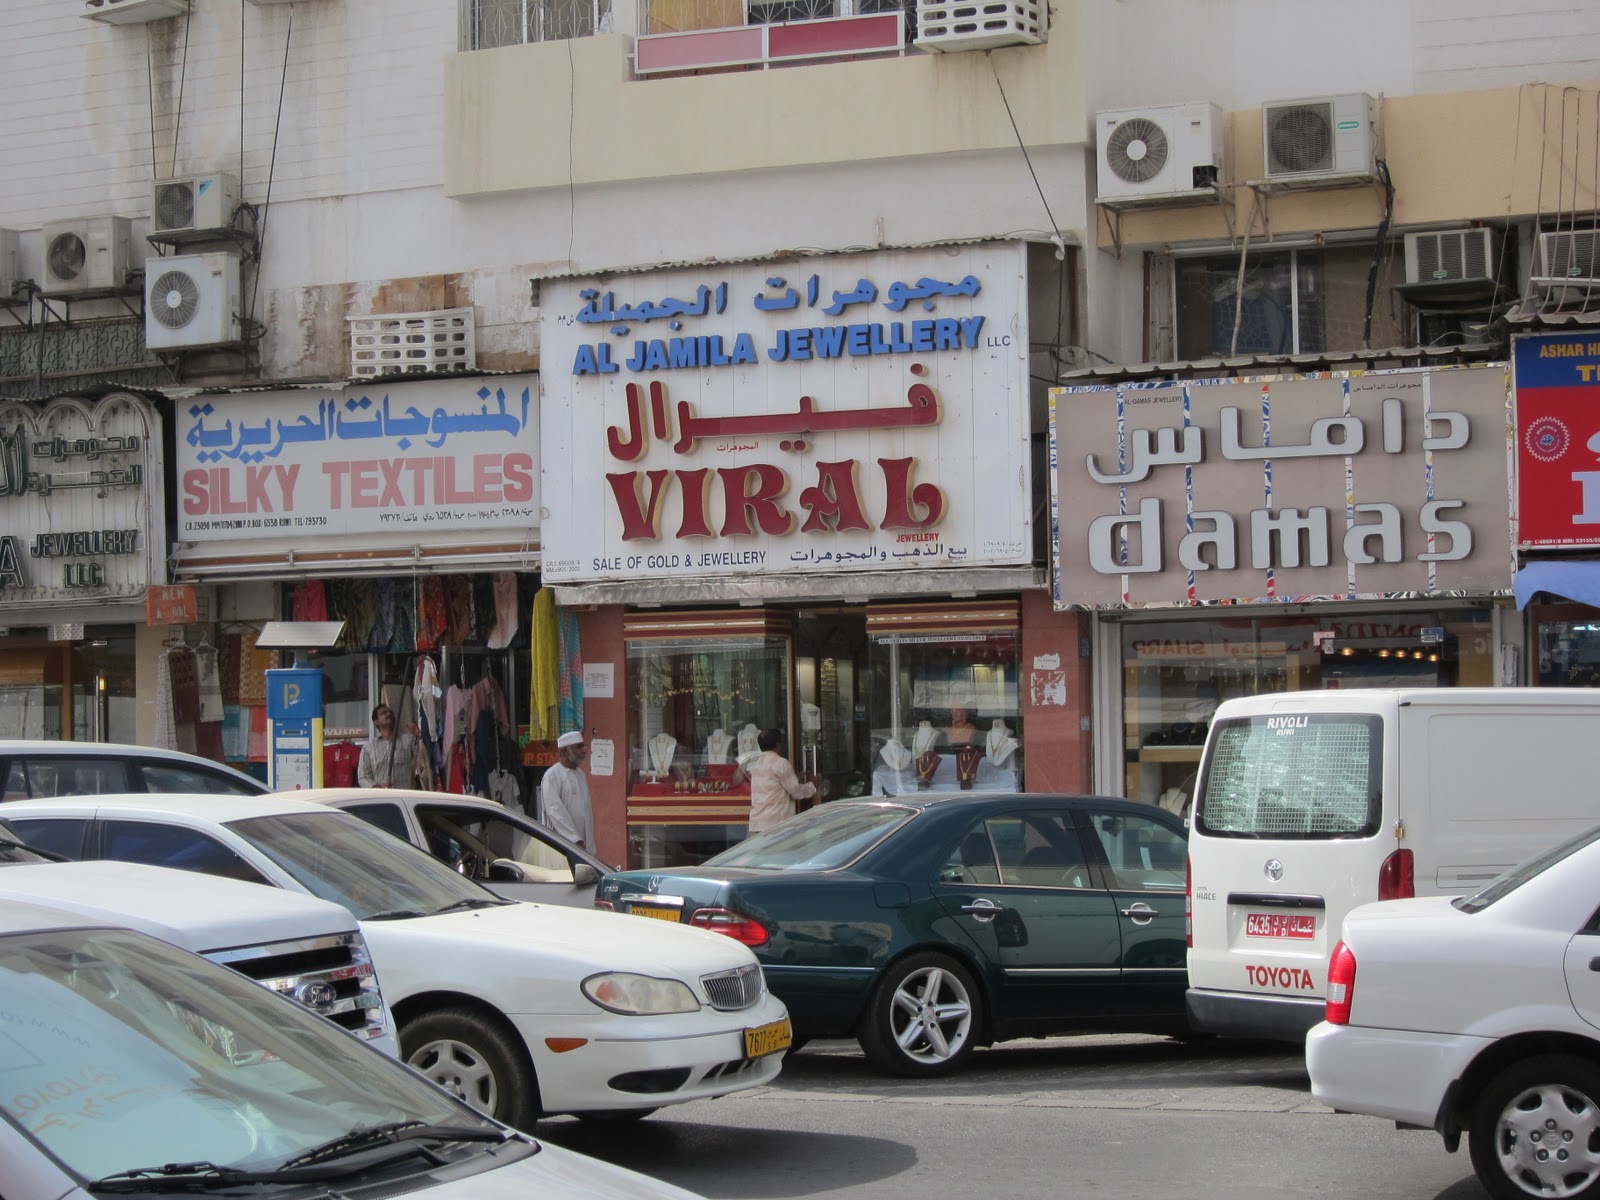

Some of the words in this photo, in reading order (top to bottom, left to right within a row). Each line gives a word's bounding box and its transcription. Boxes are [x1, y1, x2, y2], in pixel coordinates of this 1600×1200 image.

[754, 274, 983, 317] مجوهرات
[575, 280, 730, 337] الجميلة
[572, 342, 619, 376] AL
[625, 332, 759, 373] JAMILA
[767, 316, 986, 362] JEWELLERY
[987, 335, 1012, 349] LLC
[1539, 343, 1584, 358] ASHAR
[1151, 395, 1183, 404] JEWELLERY
[336, 386, 530, 451] المنسوجات
[606, 363, 944, 463] فيرال
[186, 398, 335, 464] الحريرية
[1086, 398, 1472, 485] داماس
[716, 441, 760, 453] المجوهرات
[183, 462, 301, 516] SILKY
[323, 453, 533, 510] TEXTILES
[606, 457, 949, 543] VIRAL
[264, 517, 278, 528] 6538
[30, 530, 138, 558] JEWELLERY
[896, 533, 940, 543] JEWELLERY
[1088, 498, 1474, 575] damas
[592, 557, 622, 572] SALE
[627, 556, 643, 569] OF
[647, 555, 680, 569] GOLD
[684, 554, 693, 567] &
[697, 551, 767, 567] JEWELLERY
[892, 543, 944, 558] الذهب
[947, 546, 968, 559] بيع
[63, 562, 104, 588] LLC
[162, 587, 185, 600] NEW
[1267, 716, 1308, 729] RIVOLI
[1196, 892, 1217, 901] HIACE
[1248, 915, 1271, 934] 6435
[1281, 927, 1287, 936] D
[1246, 966, 1315, 989] TOYOTA
[311, 986, 331, 1004] Ford
[748, 1030, 767, 1054] 7677
